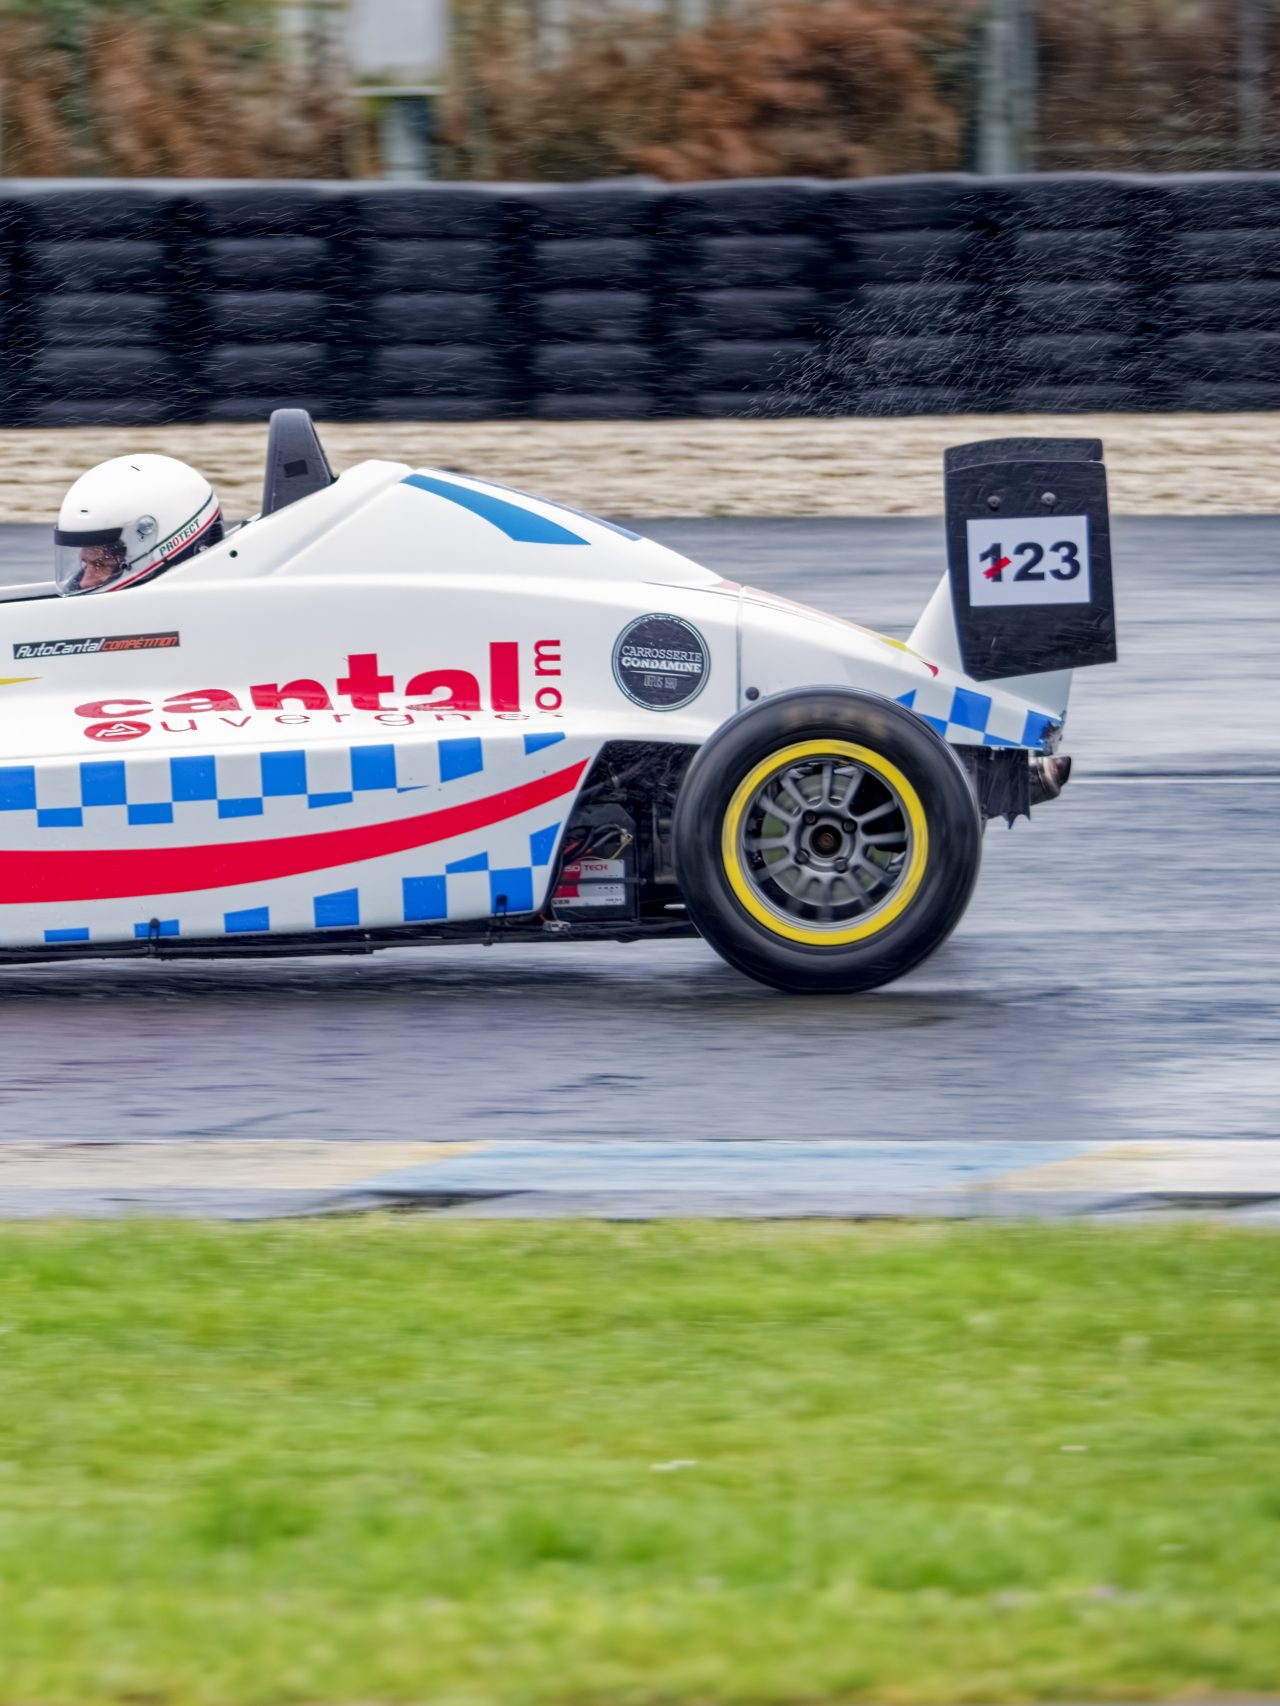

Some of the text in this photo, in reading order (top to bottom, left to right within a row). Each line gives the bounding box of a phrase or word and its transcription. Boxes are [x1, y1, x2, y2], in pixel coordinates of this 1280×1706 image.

[159, 519, 201, 557] PROTECT
[978, 540, 1081, 583] 123
[621, 645, 703, 663] CARROSSERIE
[621, 656, 703, 674] CONDAMINE
[74, 640, 522, 719] cantal
